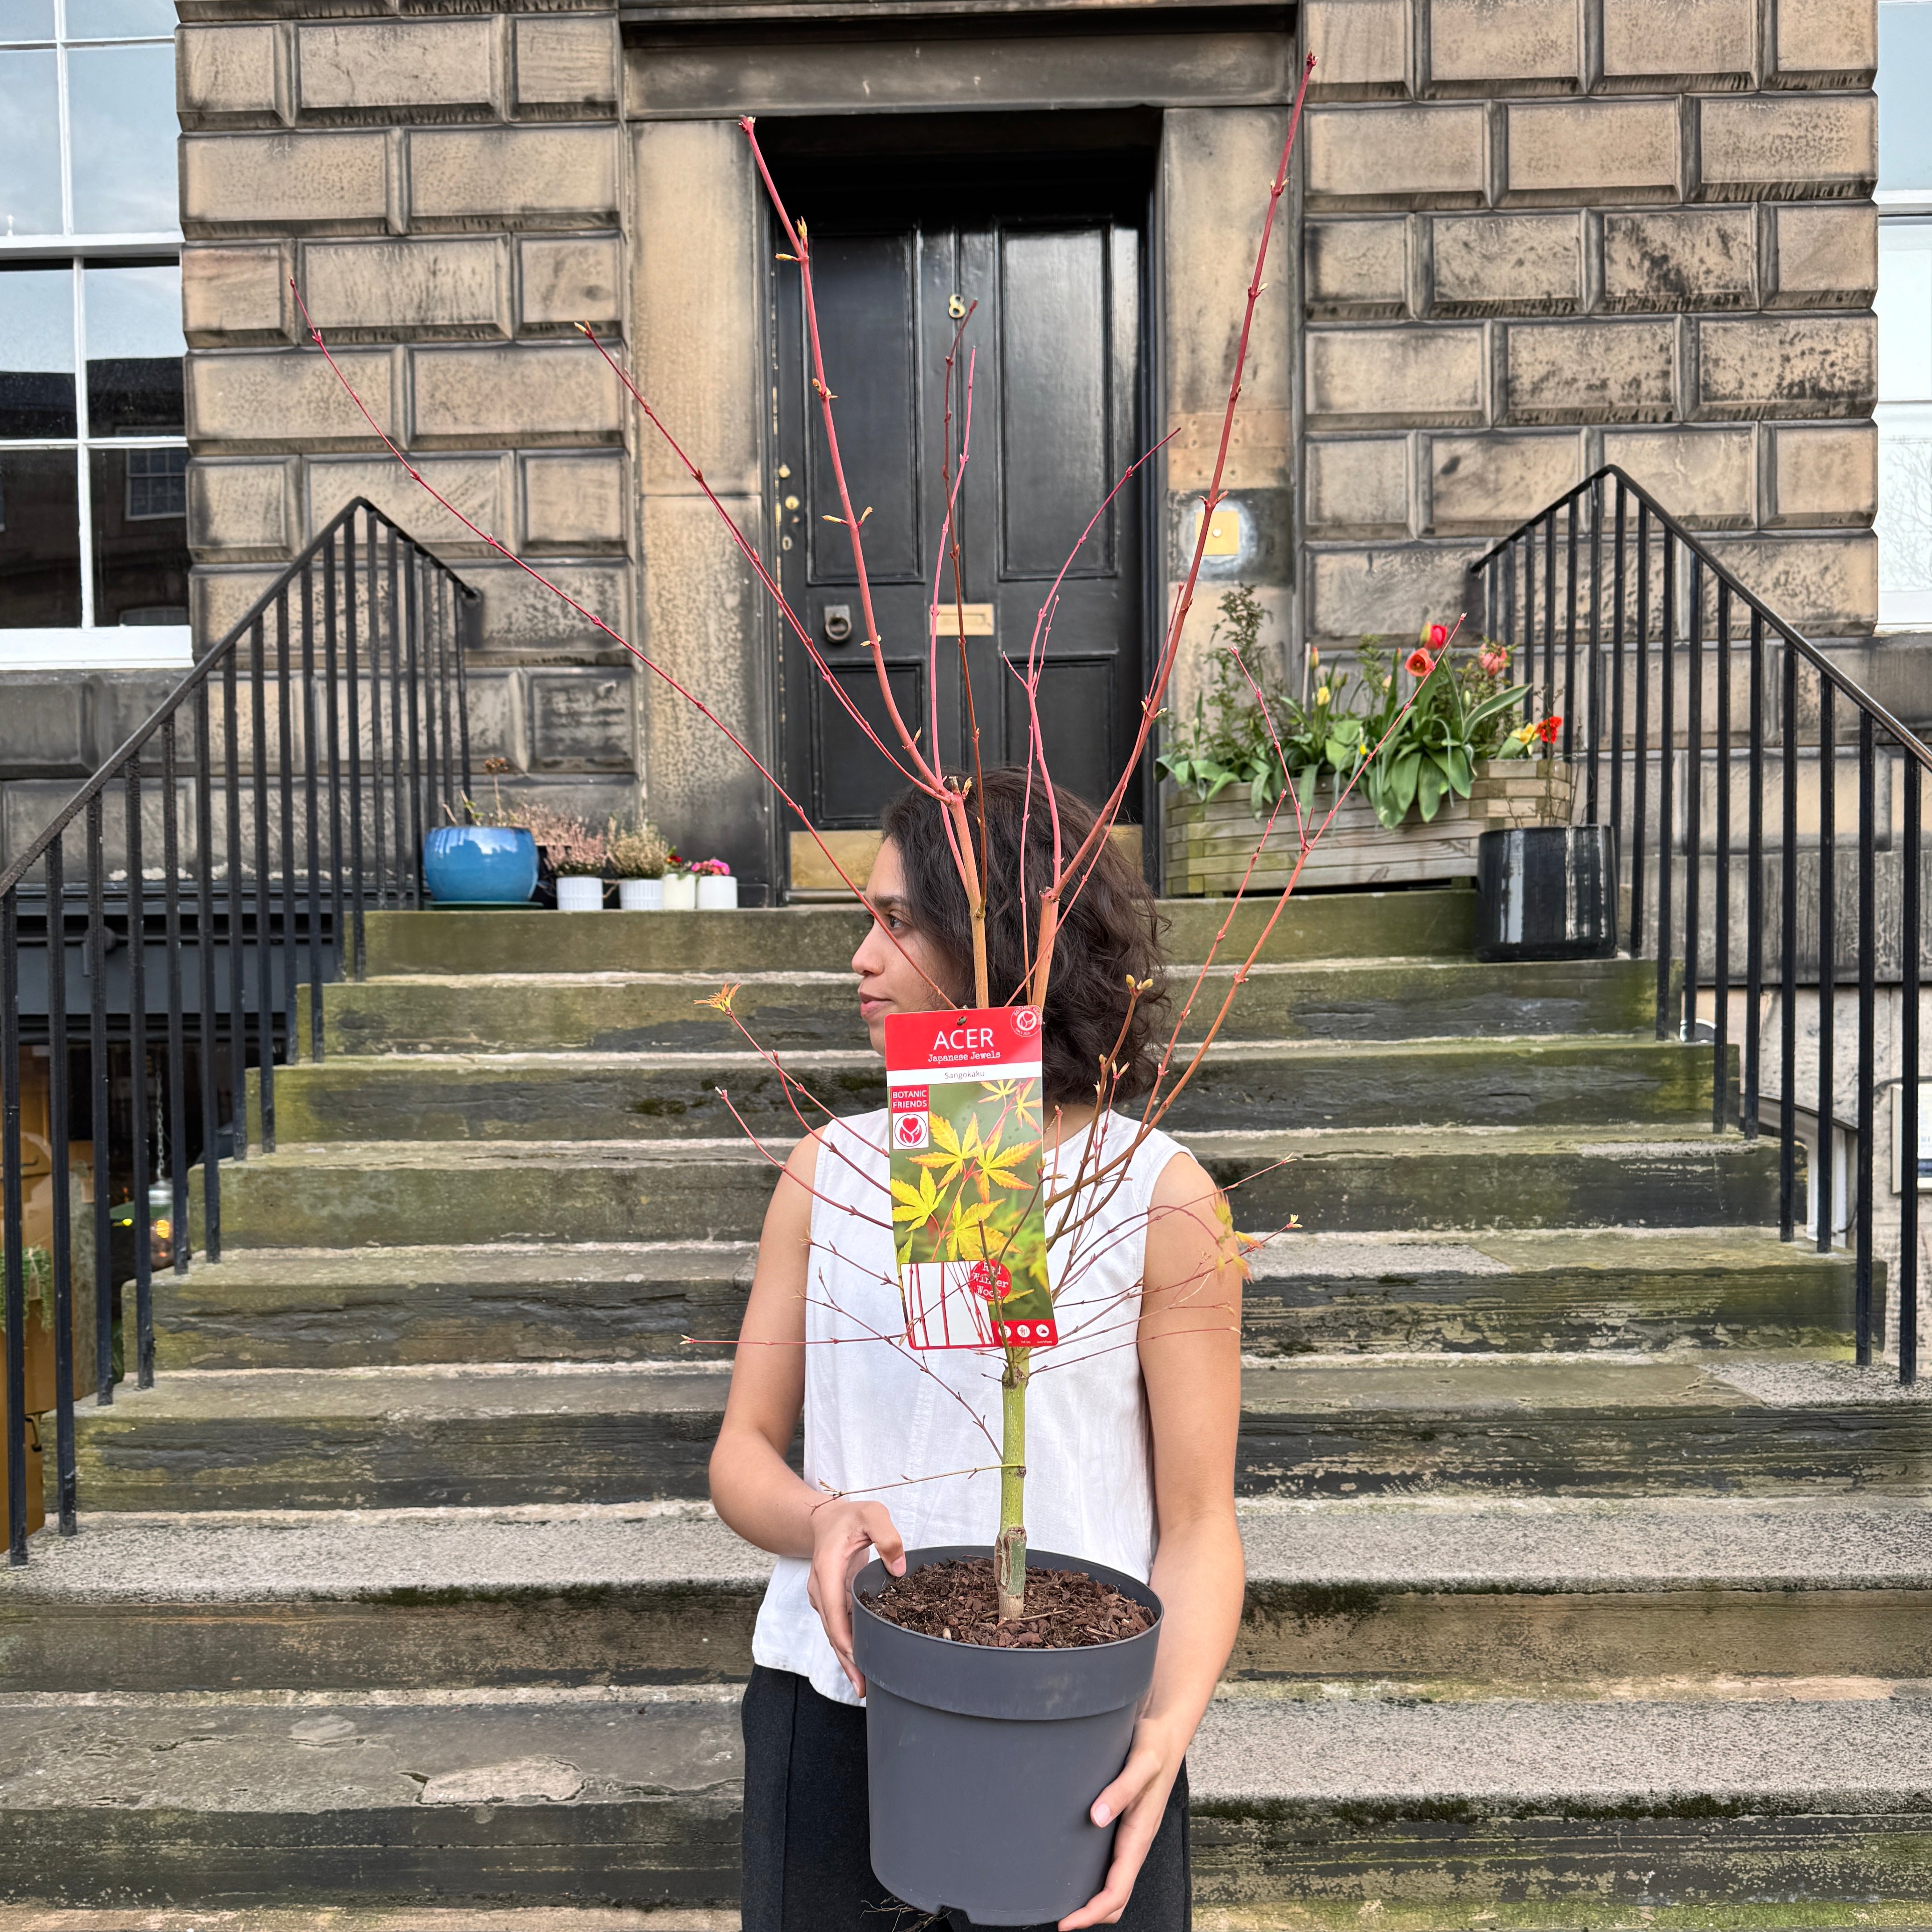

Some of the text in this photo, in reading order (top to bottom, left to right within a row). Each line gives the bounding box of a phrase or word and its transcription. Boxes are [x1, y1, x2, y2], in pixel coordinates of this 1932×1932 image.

[949, 294, 966, 318] 8
[933, 1028, 994, 1050] ACER
[928, 1051, 1001, 1064] Japanese Jewels
[944, 1070, 985, 1080] Sangokaku
[893, 1090, 927, 1099] BOTANIC
[893, 1100, 927, 1108] FRIENDS
[973, 1272, 1009, 1288] Winer
